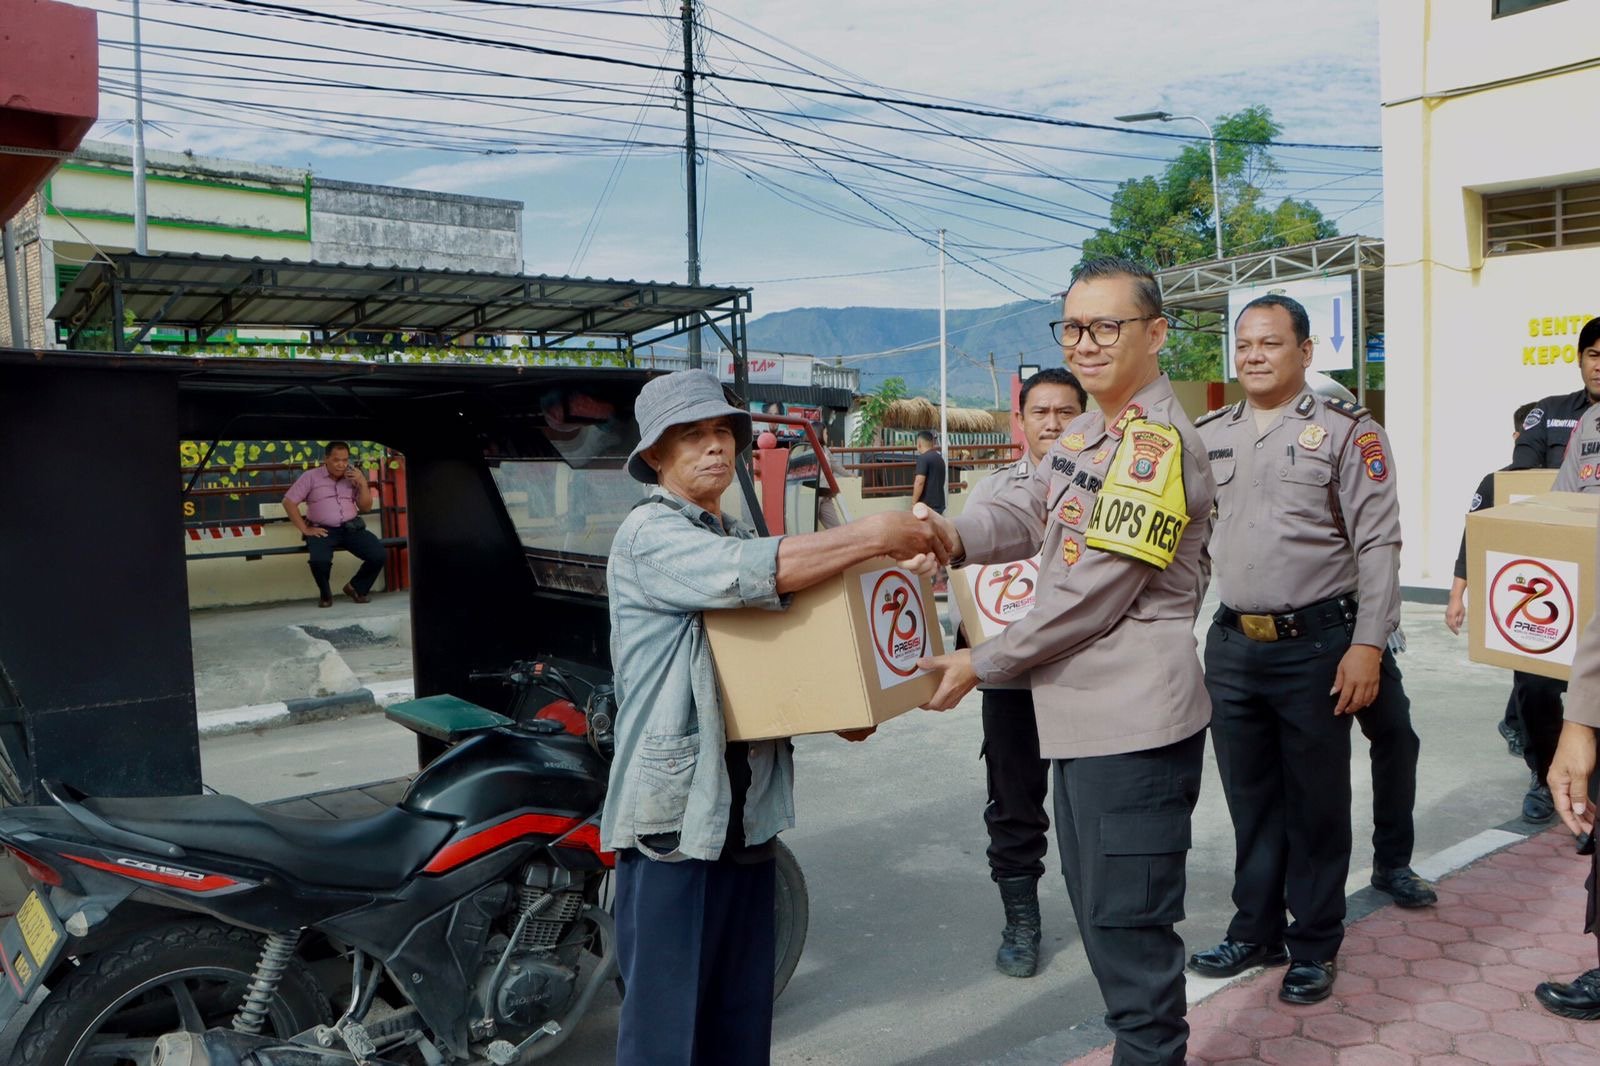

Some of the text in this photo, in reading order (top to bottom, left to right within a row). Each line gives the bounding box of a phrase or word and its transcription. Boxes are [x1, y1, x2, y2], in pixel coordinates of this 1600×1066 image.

[1522, 344, 1577, 365] KEPO
[1105, 499, 1146, 538] OPS
[1145, 511, 1183, 554] RES
[1003, 597, 1037, 612] PRESIS
[1514, 620, 1559, 637] PRESISI
[894, 636, 921, 655] PRESISI
[117, 858, 205, 880] CB150
